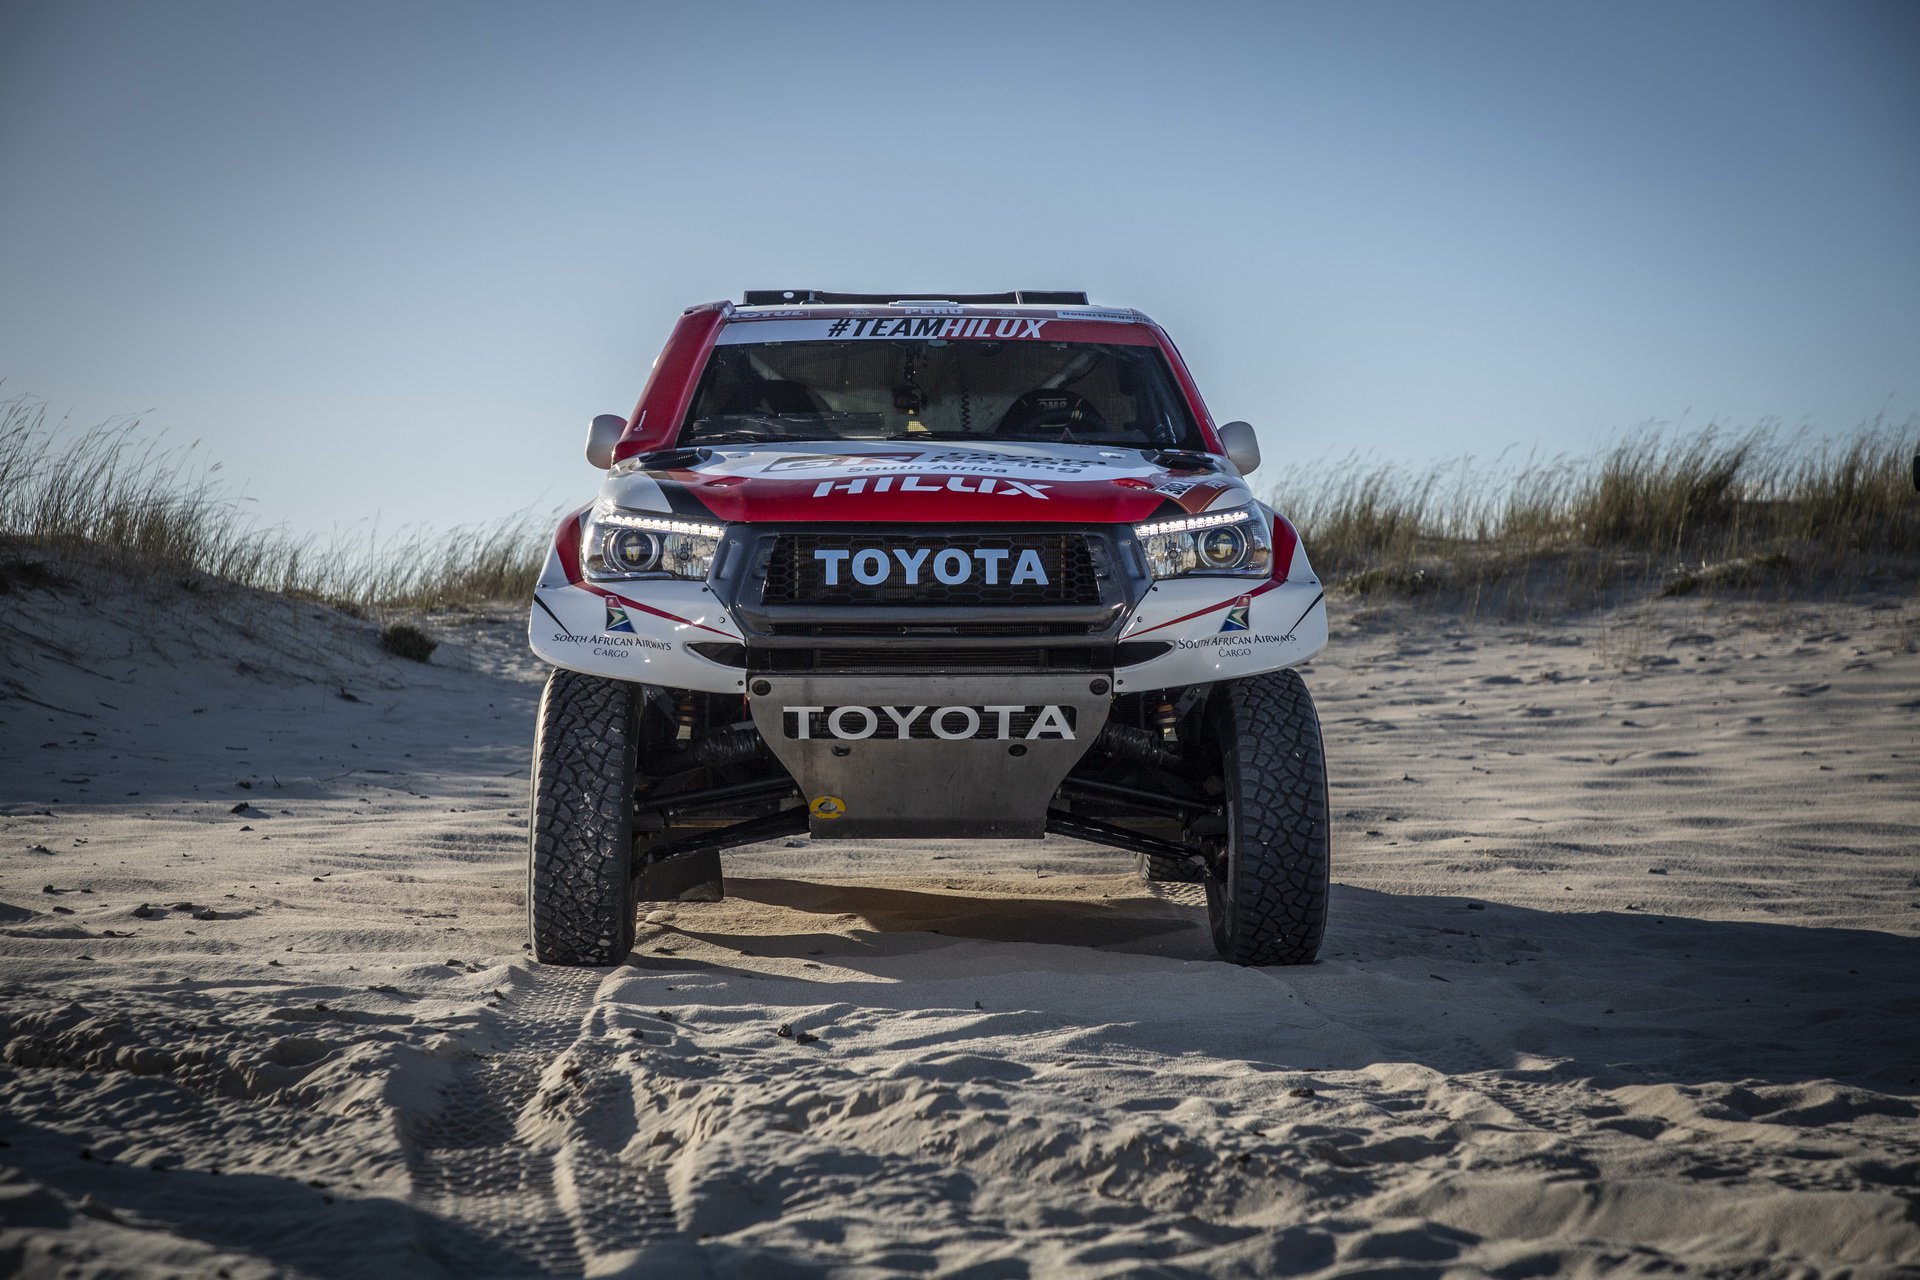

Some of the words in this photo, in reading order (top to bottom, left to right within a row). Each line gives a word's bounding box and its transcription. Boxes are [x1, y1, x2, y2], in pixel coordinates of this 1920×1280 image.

[828, 318, 1047, 338] #TEAMHILUX
[847, 465, 923, 473] South
[933, 464, 1008, 474] Africa
[812, 476, 1054, 500] HILUX
[814, 548, 1050, 585] TOYOTA
[552, 633, 588, 643] SOUTH
[589, 634, 633, 647] AFRICAN
[635, 638, 672, 651] AIRWAYS
[1178, 638, 1210, 650] SOUTH
[1211, 636, 1252, 647] AFRICAN
[1254, 634, 1297, 644] AIRWAYS
[593, 648, 629, 658] CARGO
[1218, 648, 1252, 658] CARGO
[783, 705, 1076, 740] TOYOTA
